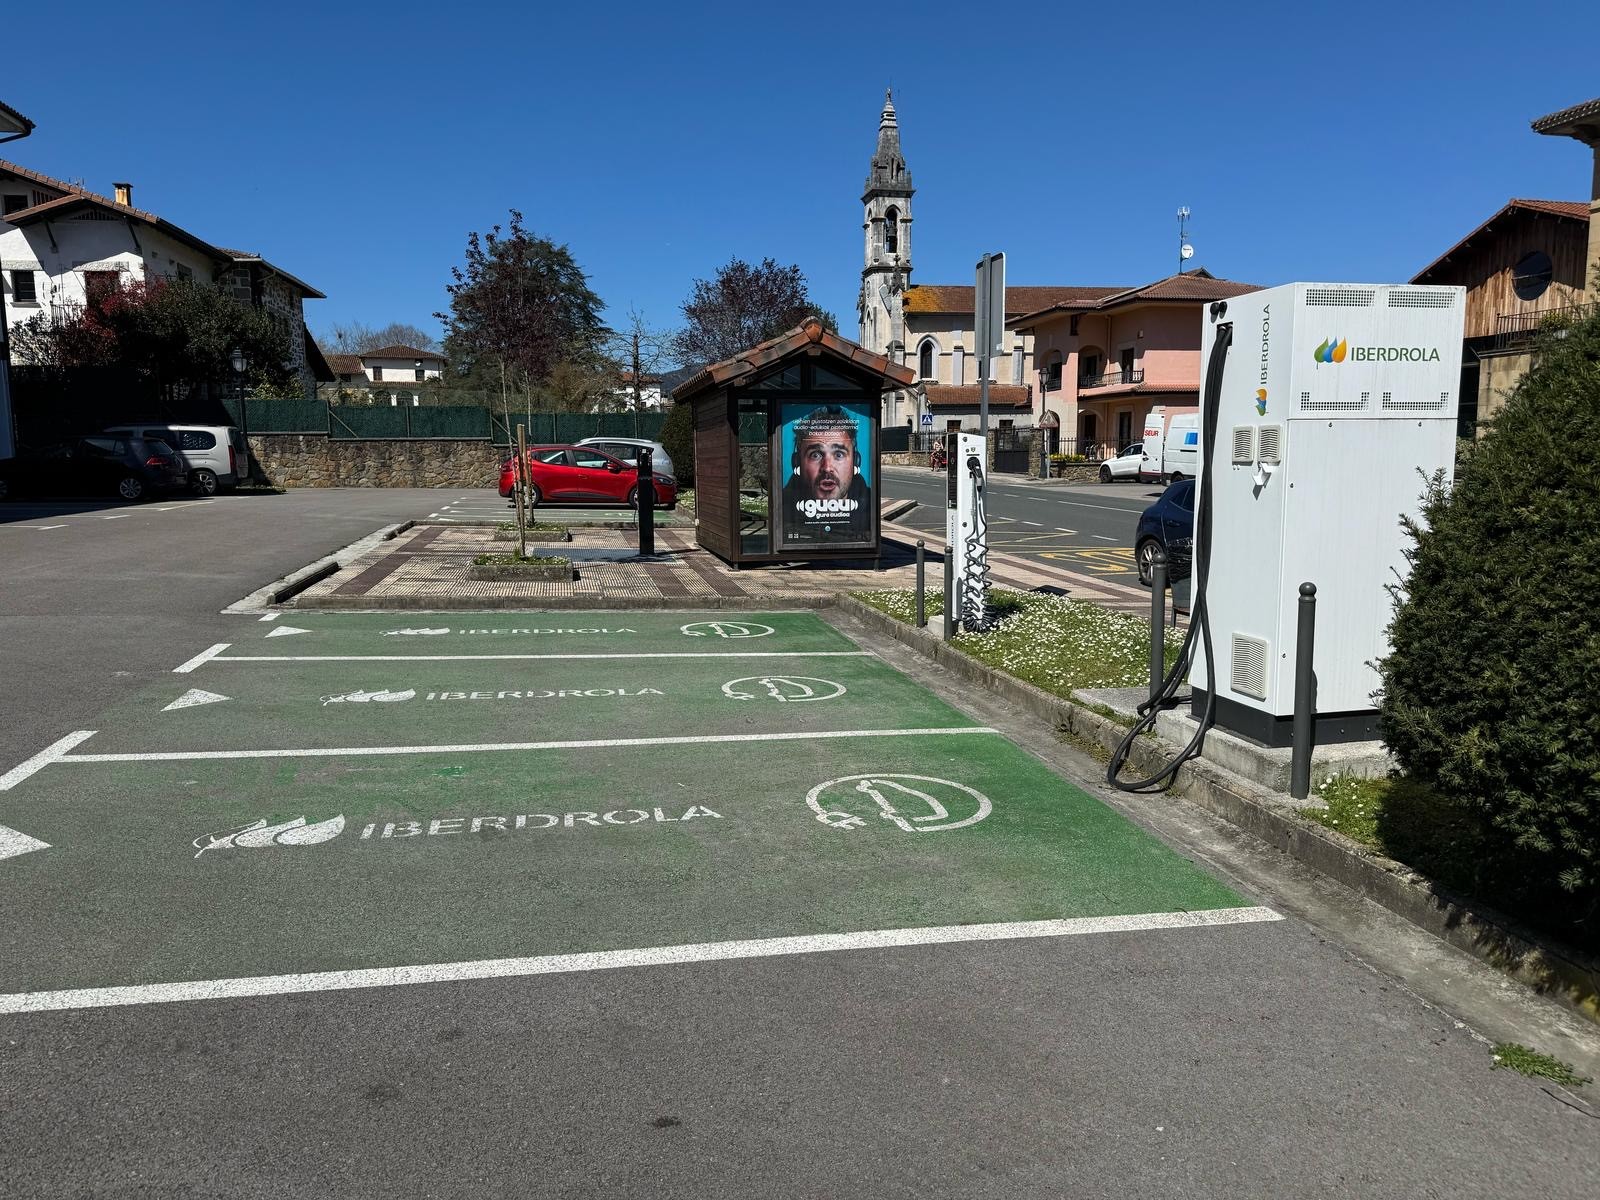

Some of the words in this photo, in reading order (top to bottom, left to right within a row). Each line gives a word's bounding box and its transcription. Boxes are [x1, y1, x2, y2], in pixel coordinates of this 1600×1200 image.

[1260, 303, 1271, 385] IBERDROLA
[1350, 346, 1441, 362] IBERDROLA
[1144, 429, 1159, 437] SEUR
[804, 499, 850, 518] guau
[459, 627, 638, 635] IBERDROLA
[426, 687, 665, 701] IBERDROLA
[359, 804, 725, 840] IBERDROLA
